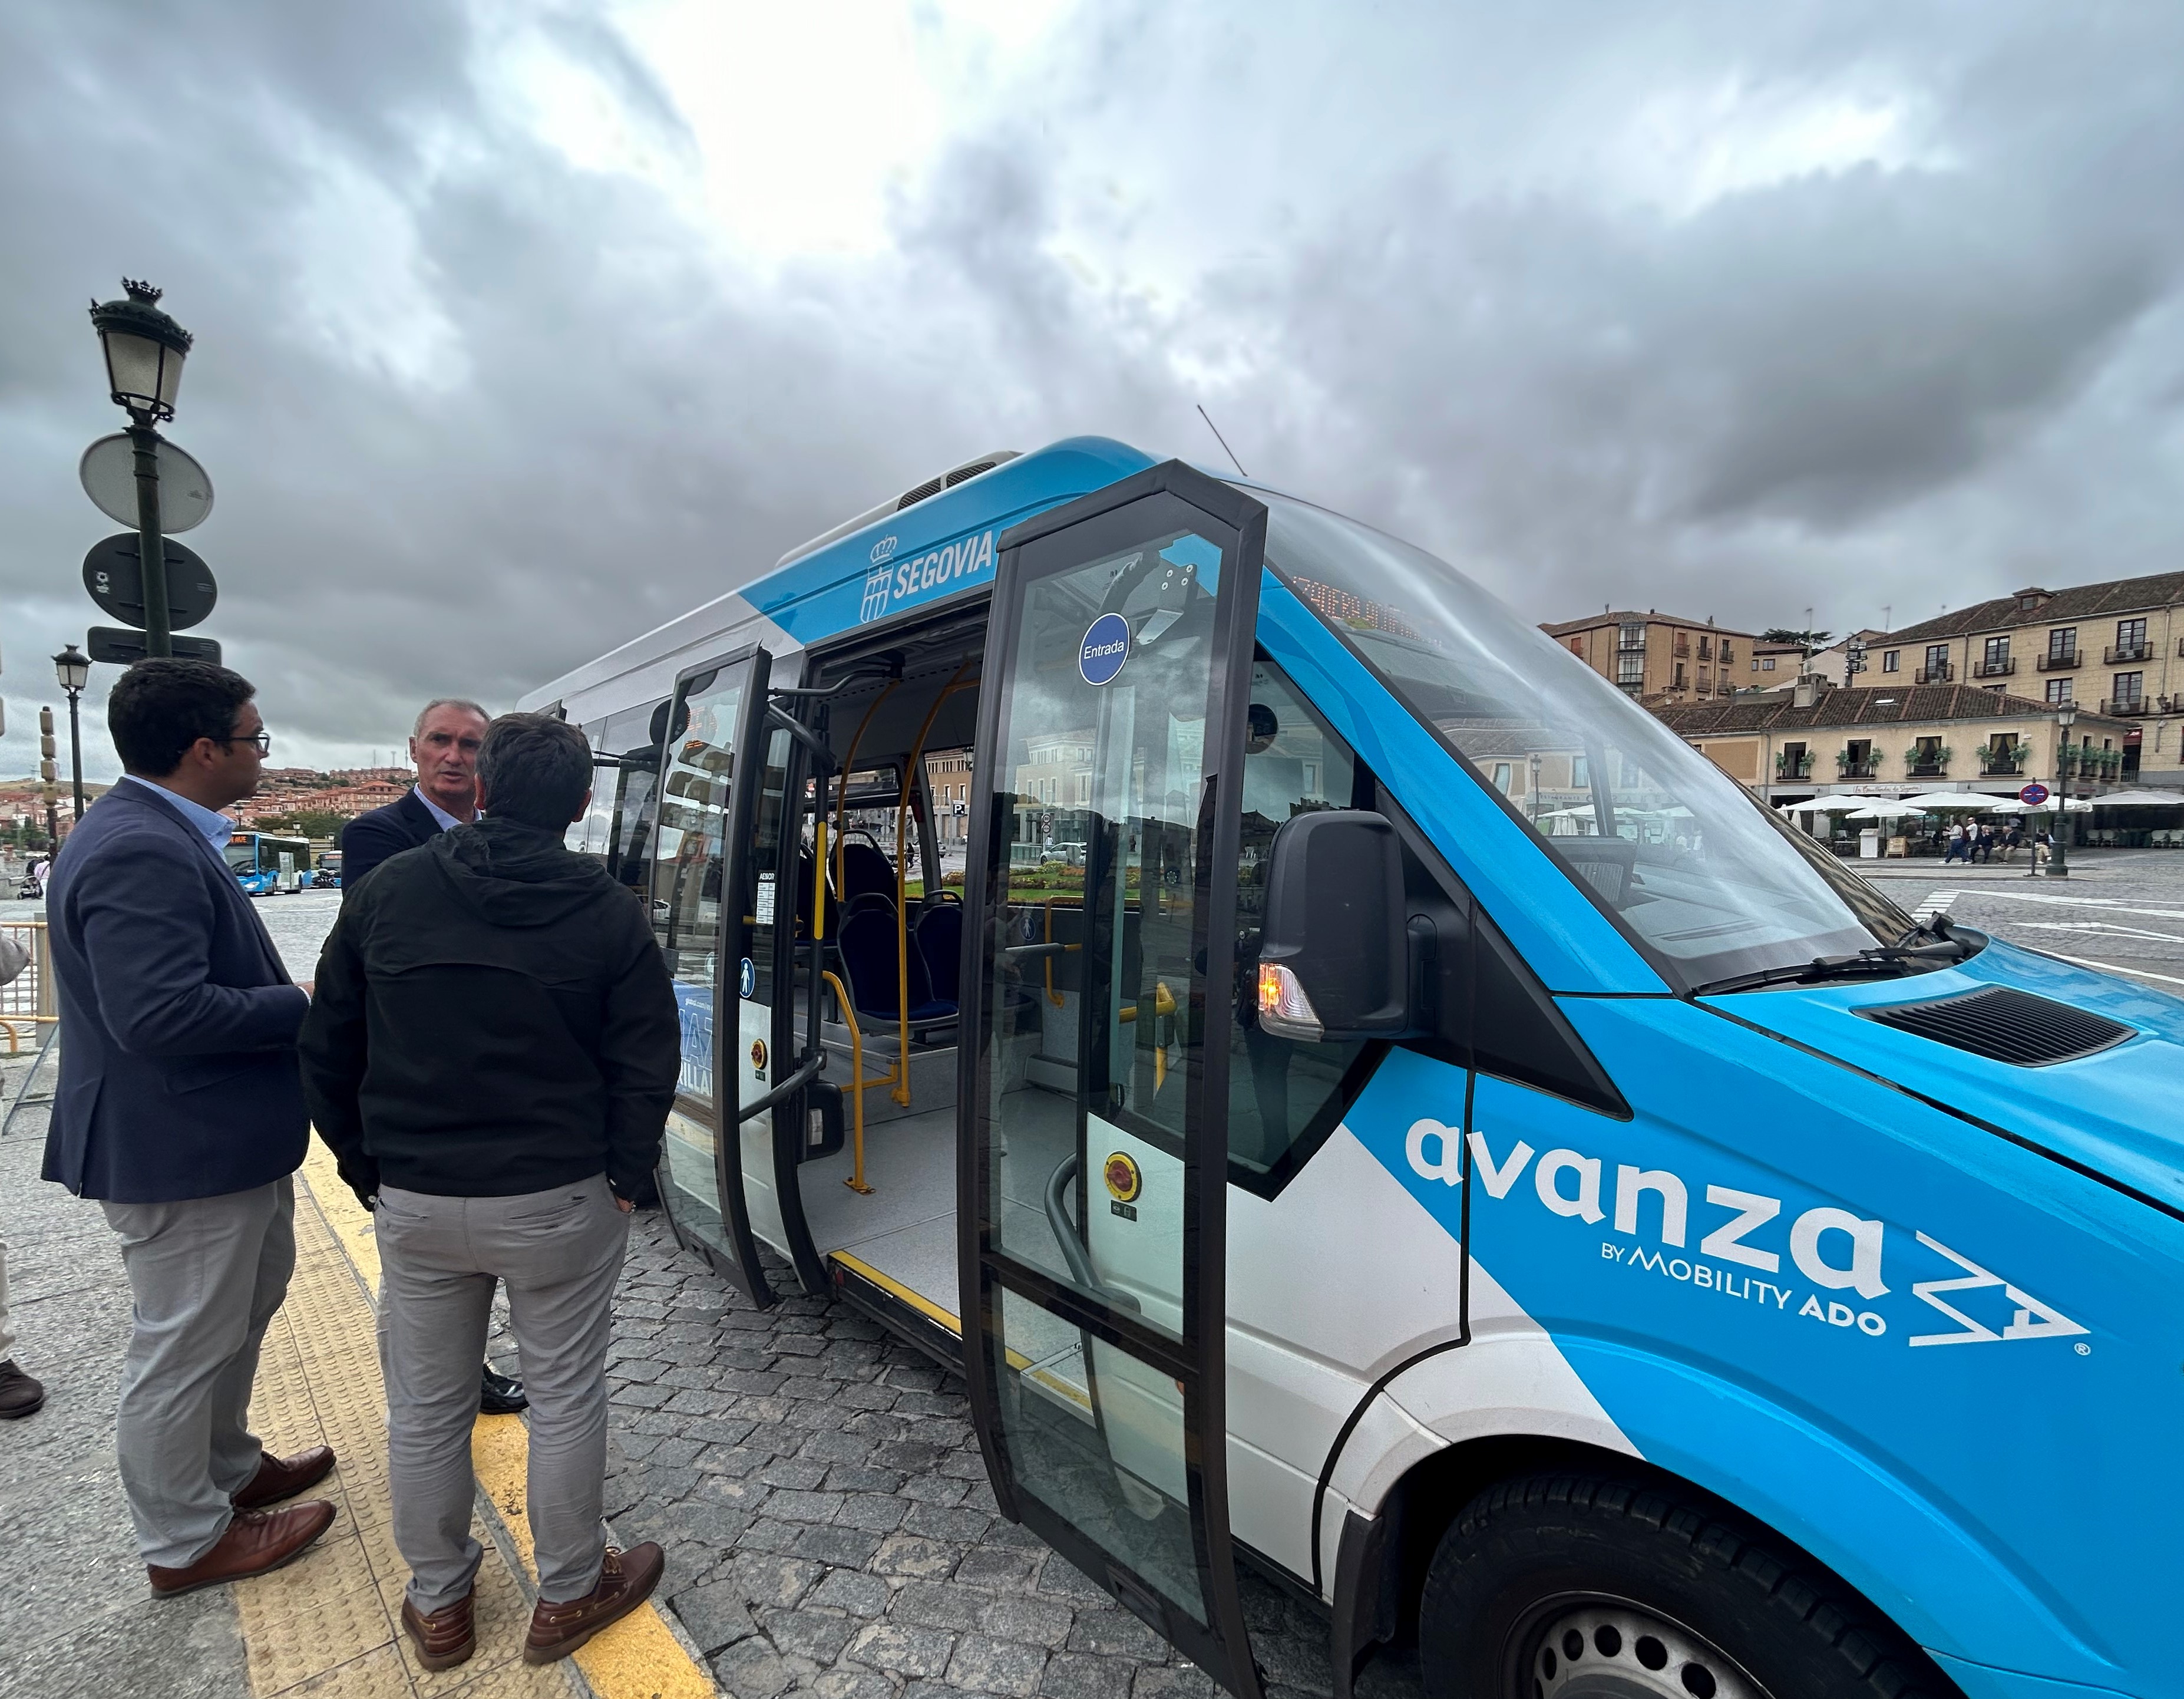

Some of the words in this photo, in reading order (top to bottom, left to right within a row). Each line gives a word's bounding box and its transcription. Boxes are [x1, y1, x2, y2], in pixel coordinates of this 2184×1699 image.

[893, 530, 992, 599] SEGOVIA
[1083, 639, 1125, 659] Entrada
[1405, 1117, 1891, 1299] avanza
[1601, 1242, 1625, 1262] BY
[1627, 1246, 1792, 1309] MOBILITY
[1799, 1294, 1886, 1336] ADO
